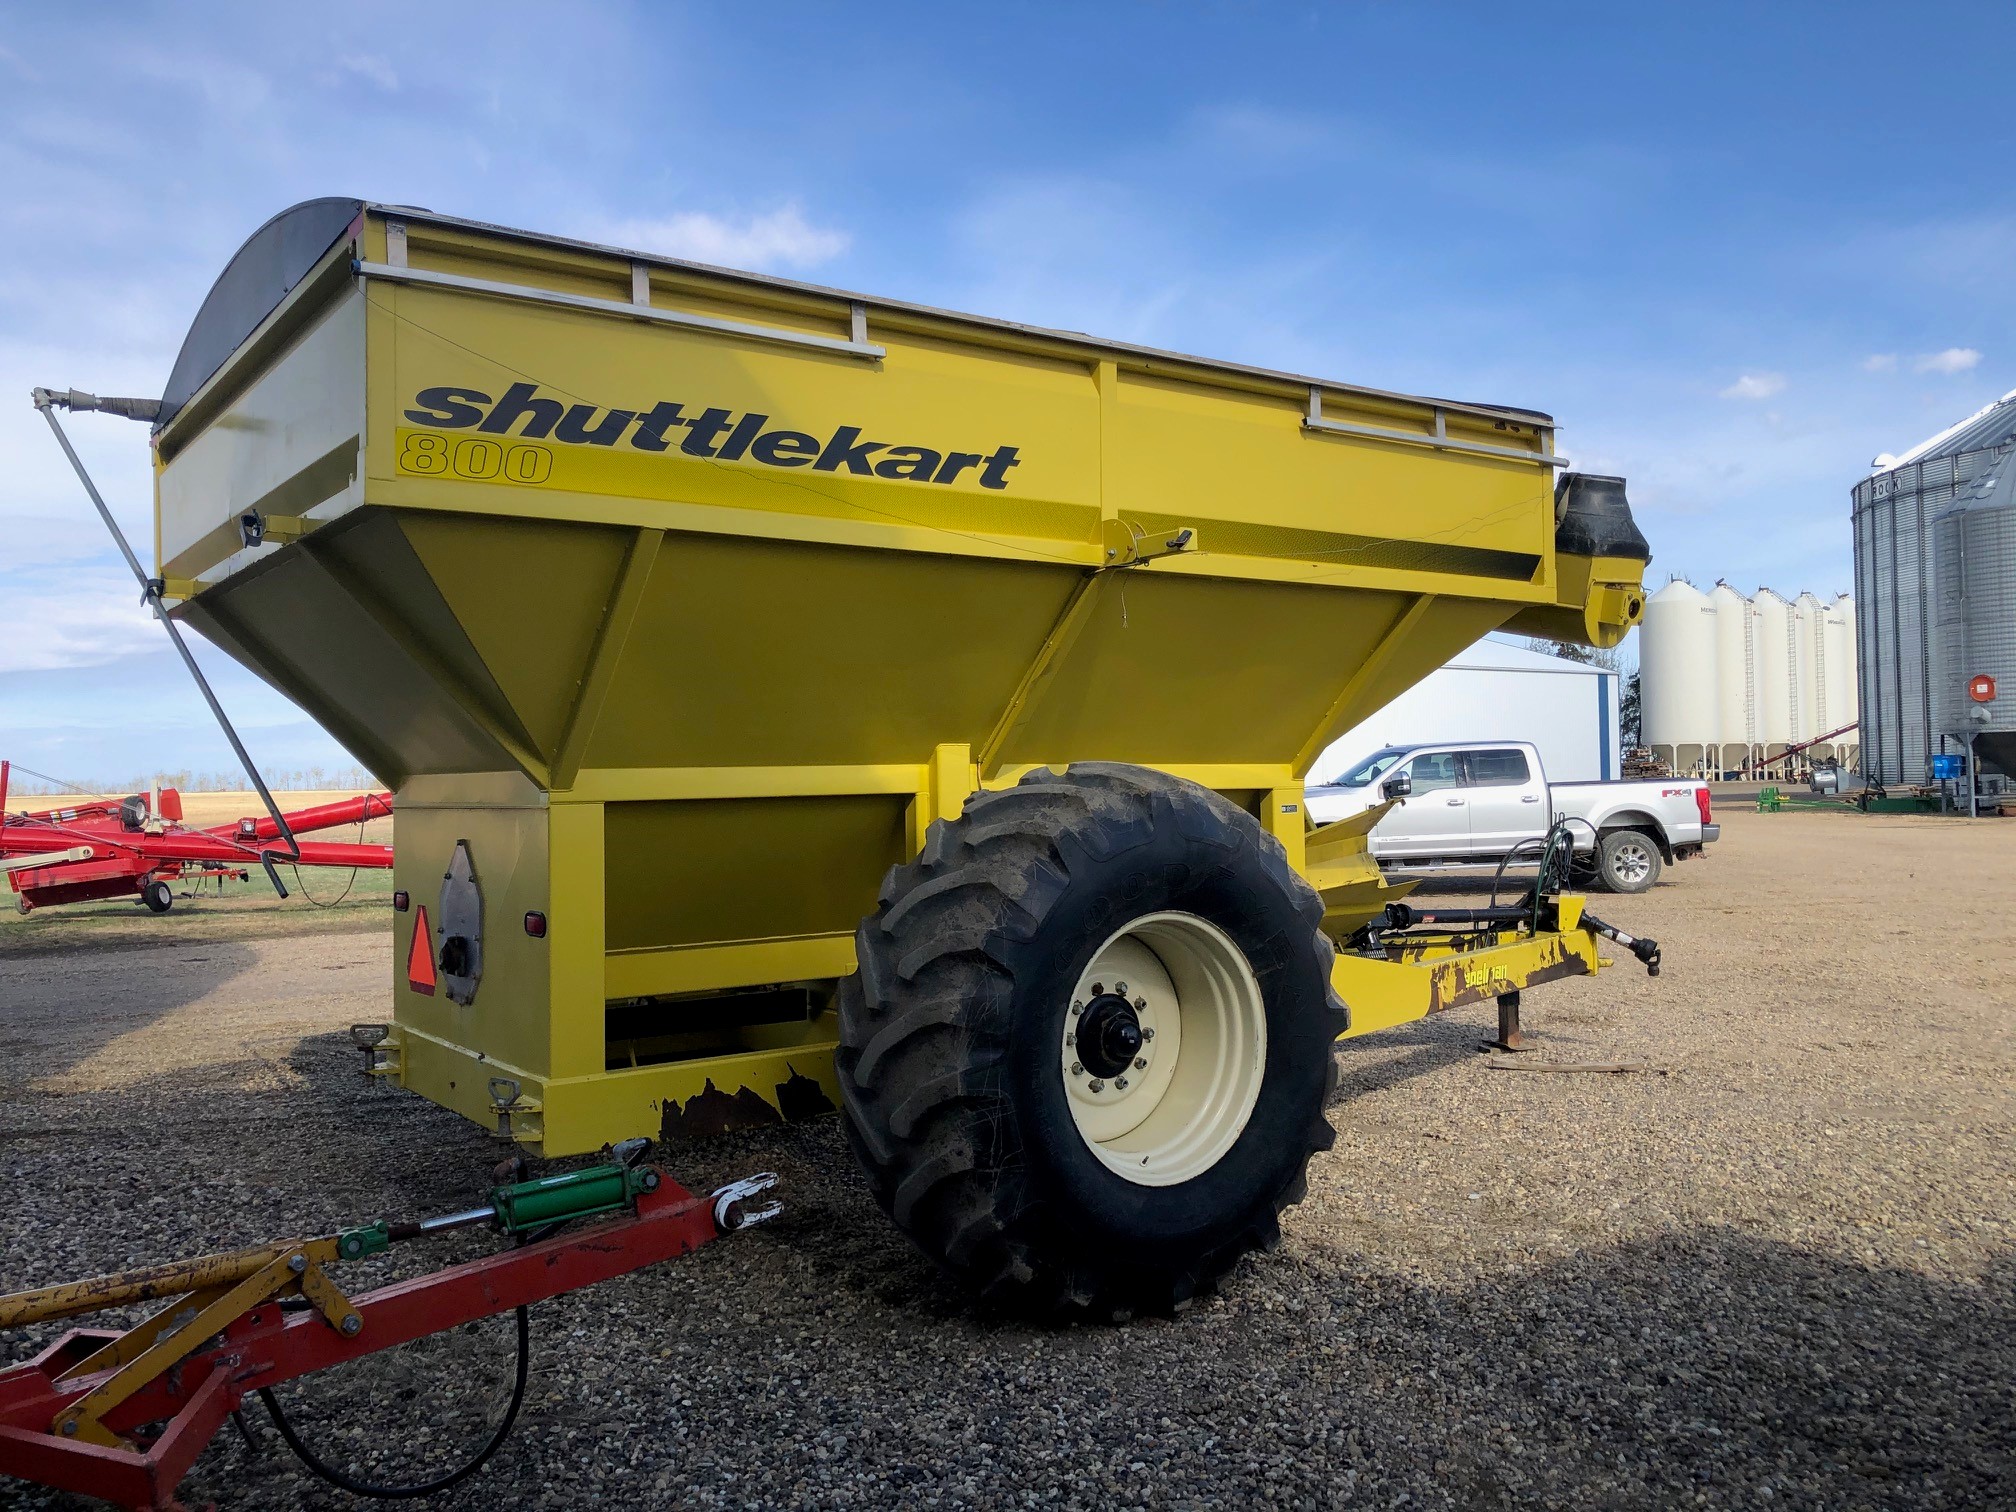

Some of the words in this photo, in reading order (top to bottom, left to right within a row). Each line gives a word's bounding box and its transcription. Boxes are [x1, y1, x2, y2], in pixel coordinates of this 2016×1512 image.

[400, 433, 554, 485] 800
[404, 382, 1021, 490] shuttlekart
[1661, 789, 1691, 798] FX4
